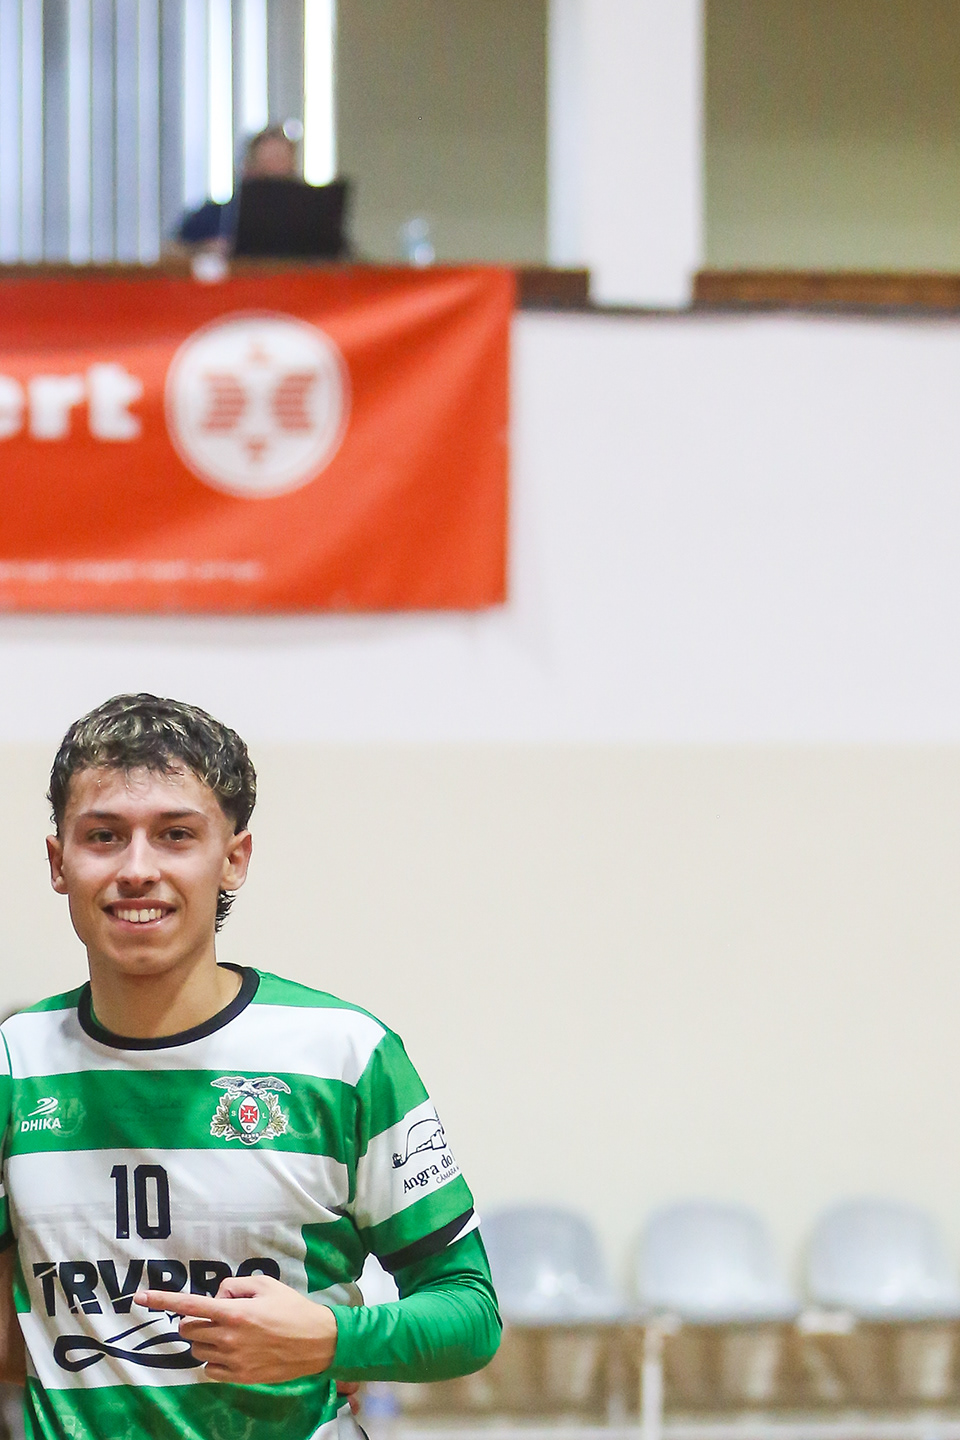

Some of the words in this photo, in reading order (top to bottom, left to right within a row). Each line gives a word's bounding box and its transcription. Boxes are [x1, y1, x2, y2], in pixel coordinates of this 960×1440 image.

[21, 1117, 62, 1133] DHIKA
[403, 1164, 440, 1194] Angra
[110, 1164, 171, 1239] 10
